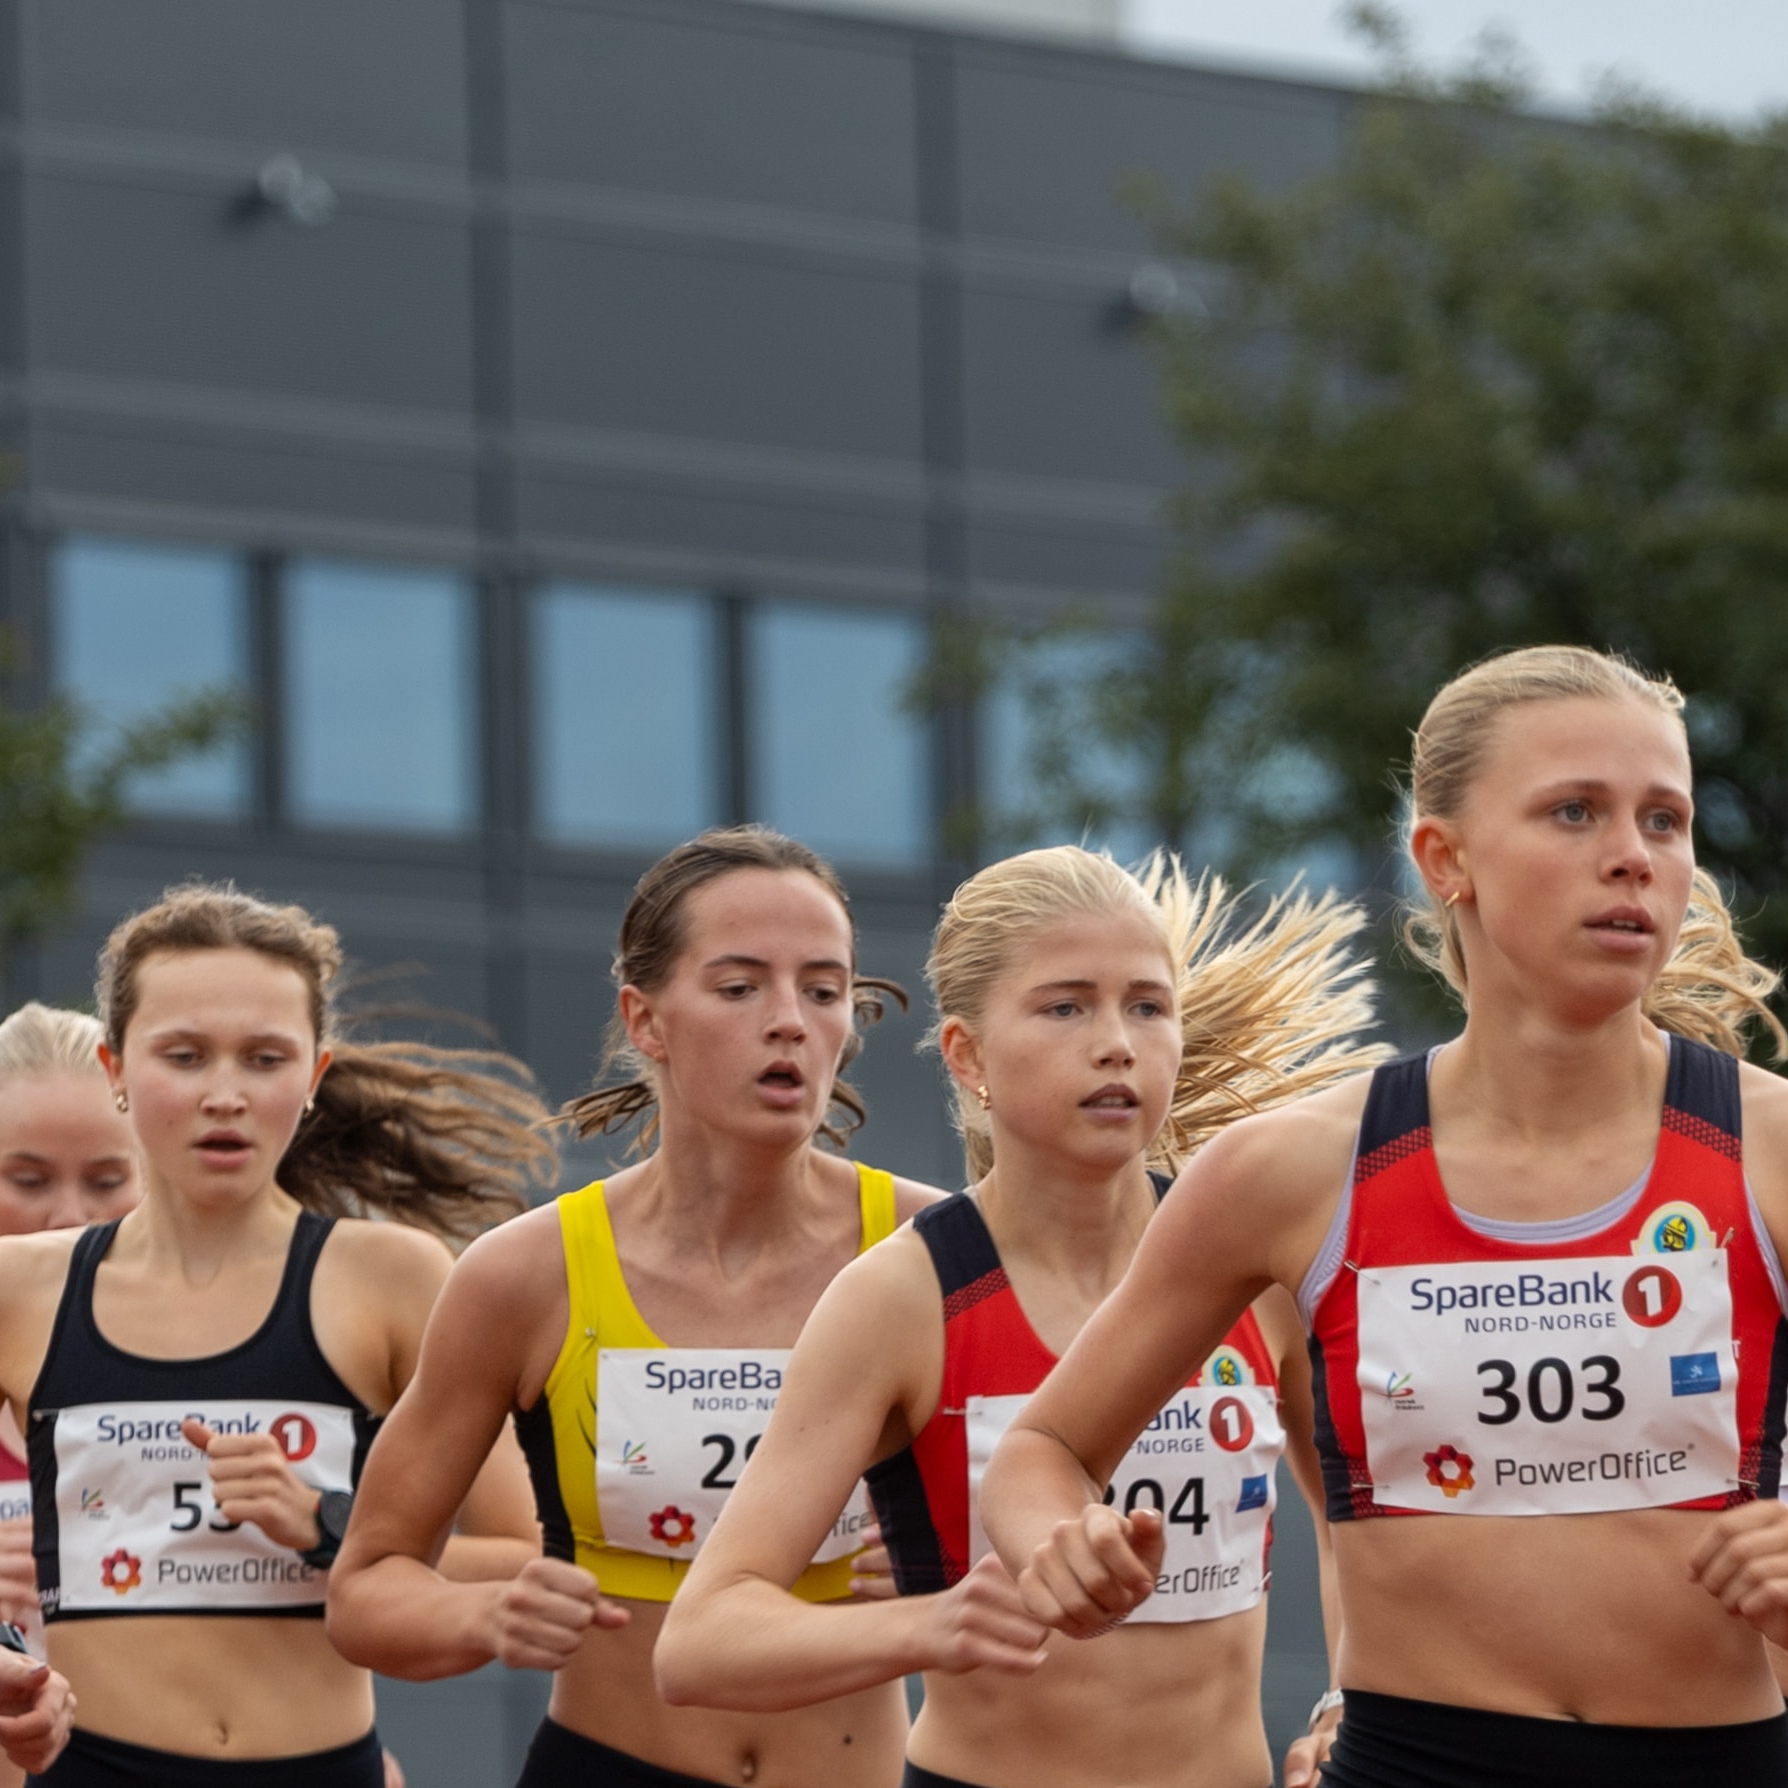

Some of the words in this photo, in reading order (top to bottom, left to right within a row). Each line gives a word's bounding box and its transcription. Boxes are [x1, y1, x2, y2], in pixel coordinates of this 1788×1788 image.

[1411, 1271, 1615, 1316] SpareBank
[1464, 1312, 1617, 1334] NORD-NORGE
[645, 1361, 782, 1394] SpareBa
[1476, 1354, 1626, 1426] 303
[693, 1397, 777, 1411] NORD-N
[1131, 1437, 1205, 1455] -NORGE
[1495, 1447, 1688, 1486] PowerOffice
[158, 1556, 315, 1585] PowerOffice
[1154, 1563, 1241, 1595] erOffice
